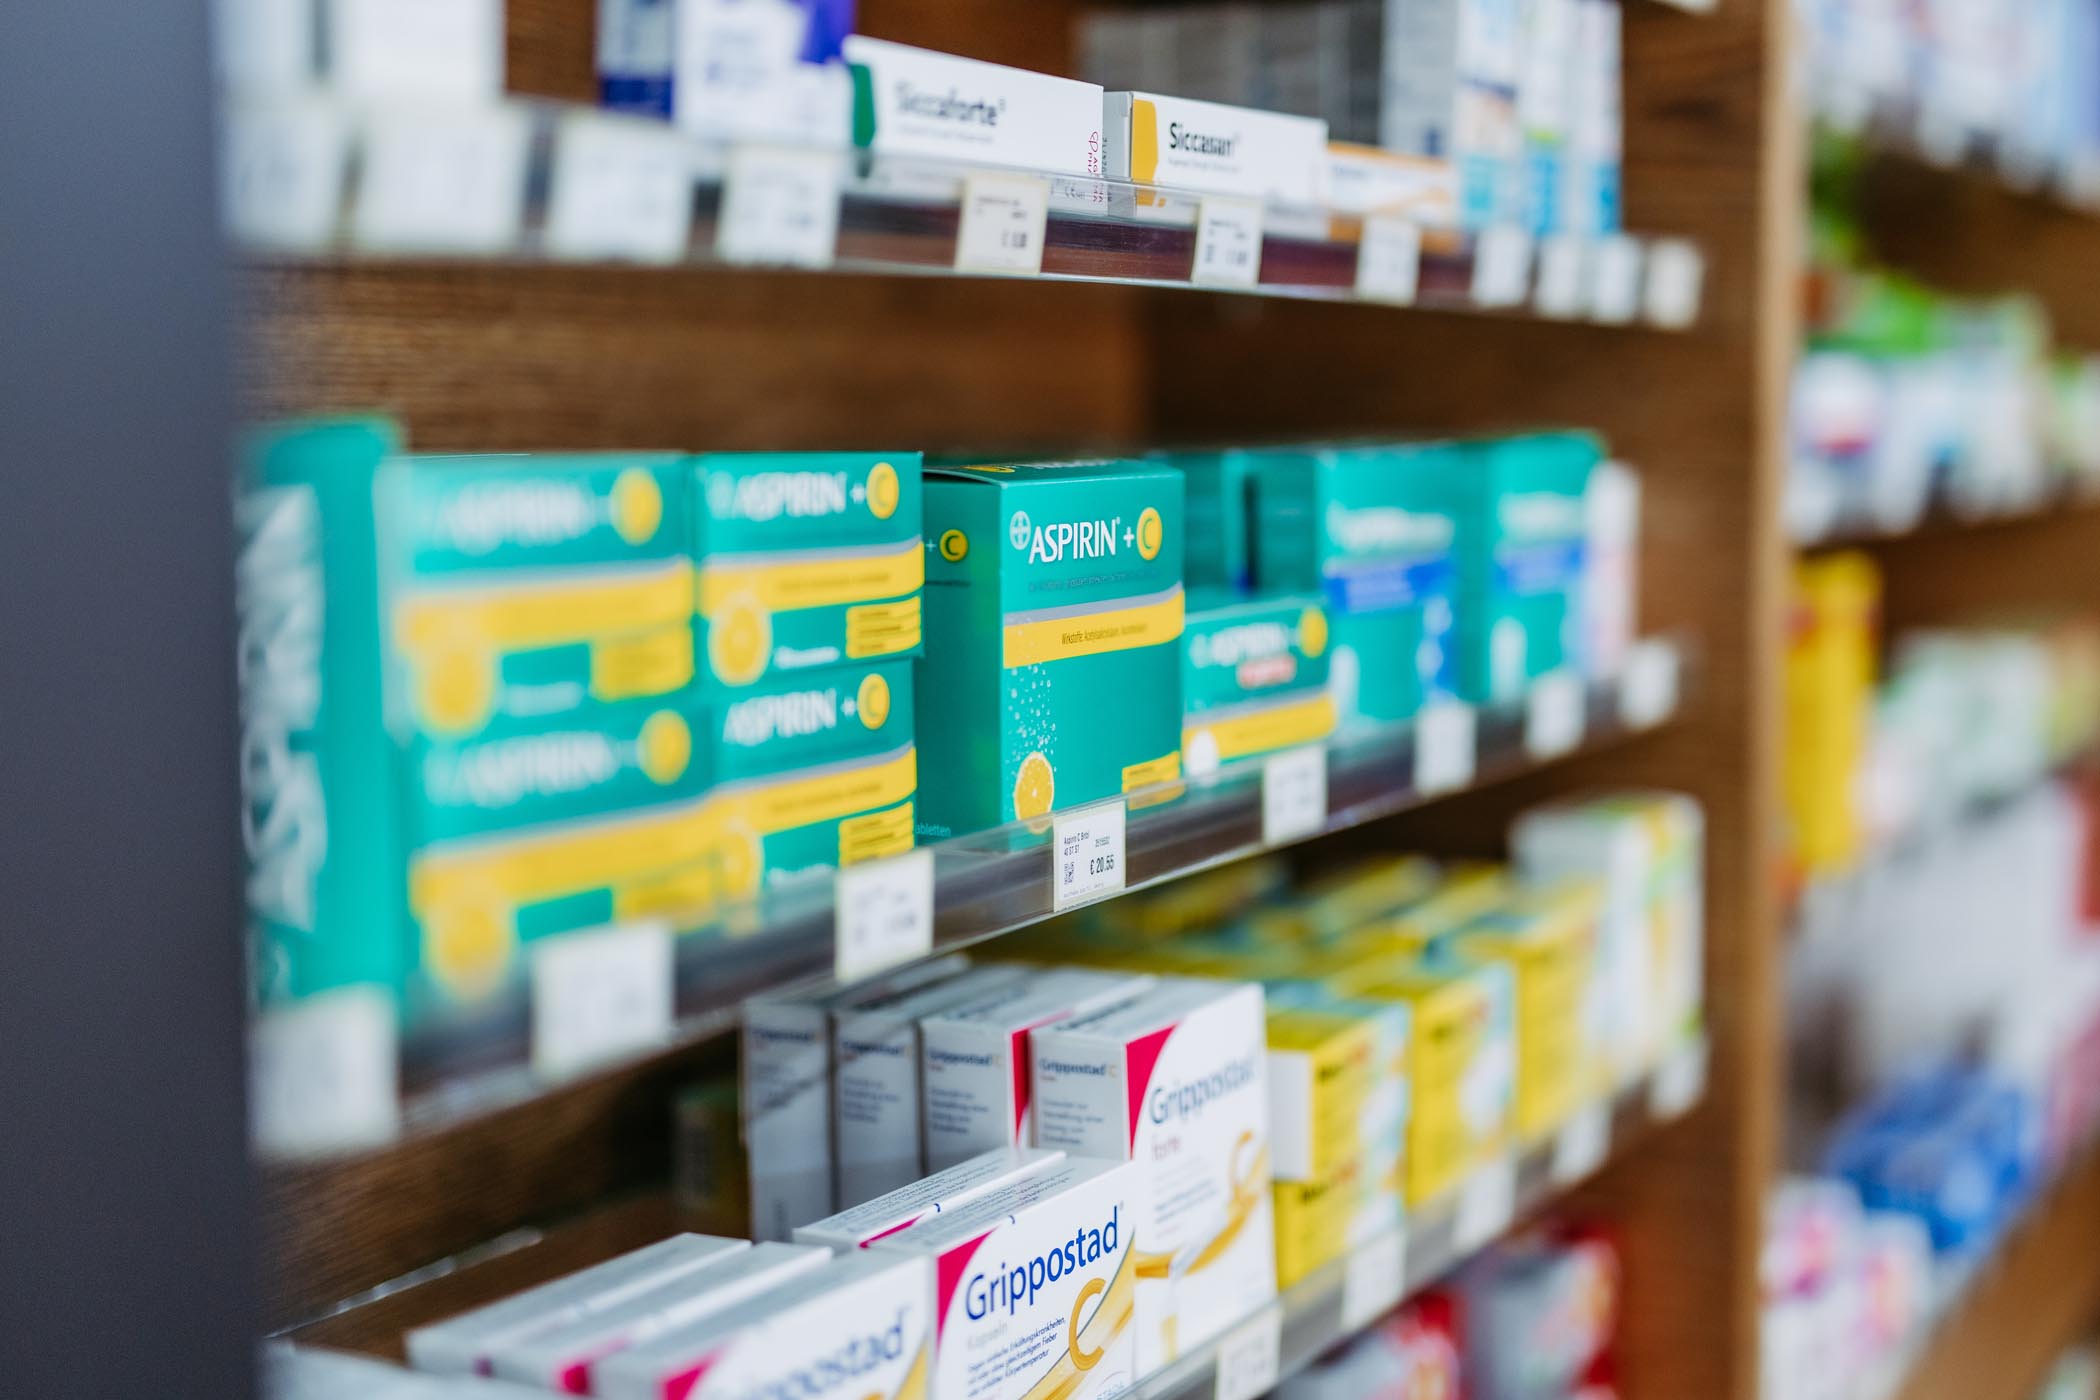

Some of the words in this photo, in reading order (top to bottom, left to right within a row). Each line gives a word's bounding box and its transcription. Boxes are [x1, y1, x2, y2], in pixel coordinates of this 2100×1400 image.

[1029, 518, 1116, 565] ASPIRIN
[723, 687, 837, 747] ASPIRIN
[1096, 855, 1114, 873] 20.55
[1040, 1057, 1106, 1077] Grippostad
[1150, 1055, 1258, 1126] Grippostad
[965, 1205, 1118, 1321] Grippostad
[1068, 1277, 1106, 1371] C
